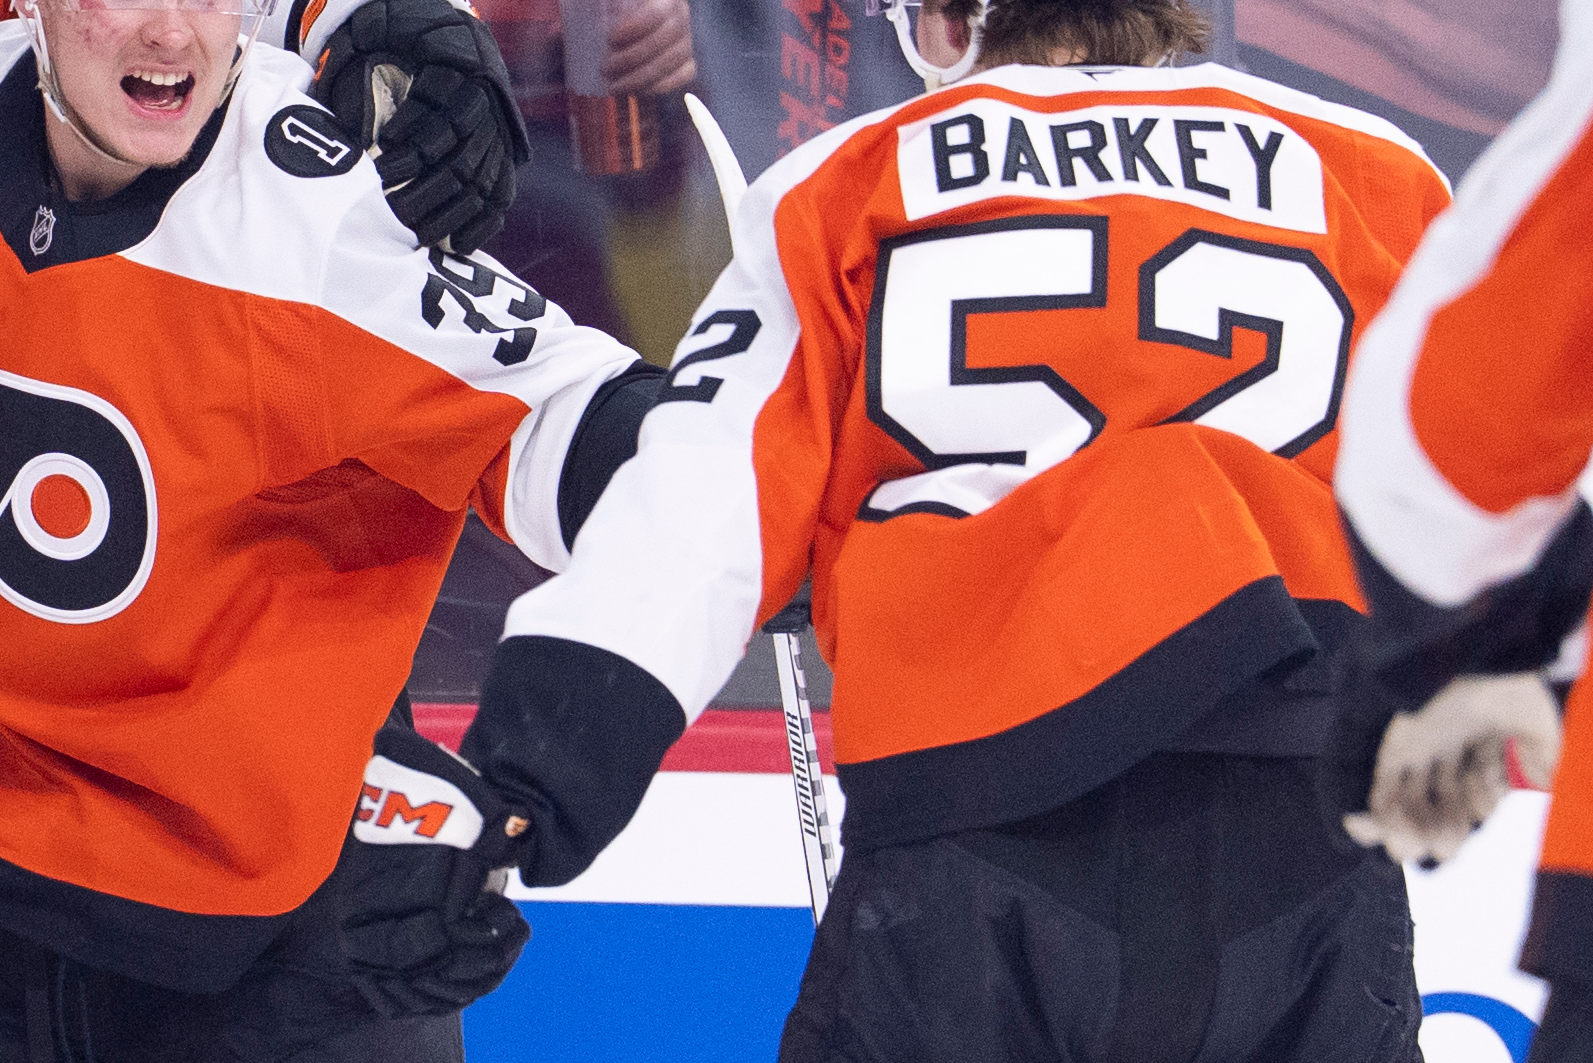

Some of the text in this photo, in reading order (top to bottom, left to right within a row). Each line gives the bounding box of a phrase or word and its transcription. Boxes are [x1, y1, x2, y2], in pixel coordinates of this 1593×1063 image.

[280, 115, 351, 167] 1
[929, 112, 1285, 212] BARKEY
[420, 247, 548, 367] 39
[854, 213, 1356, 524] 52
[785, 711, 817, 838] WARRIOR
